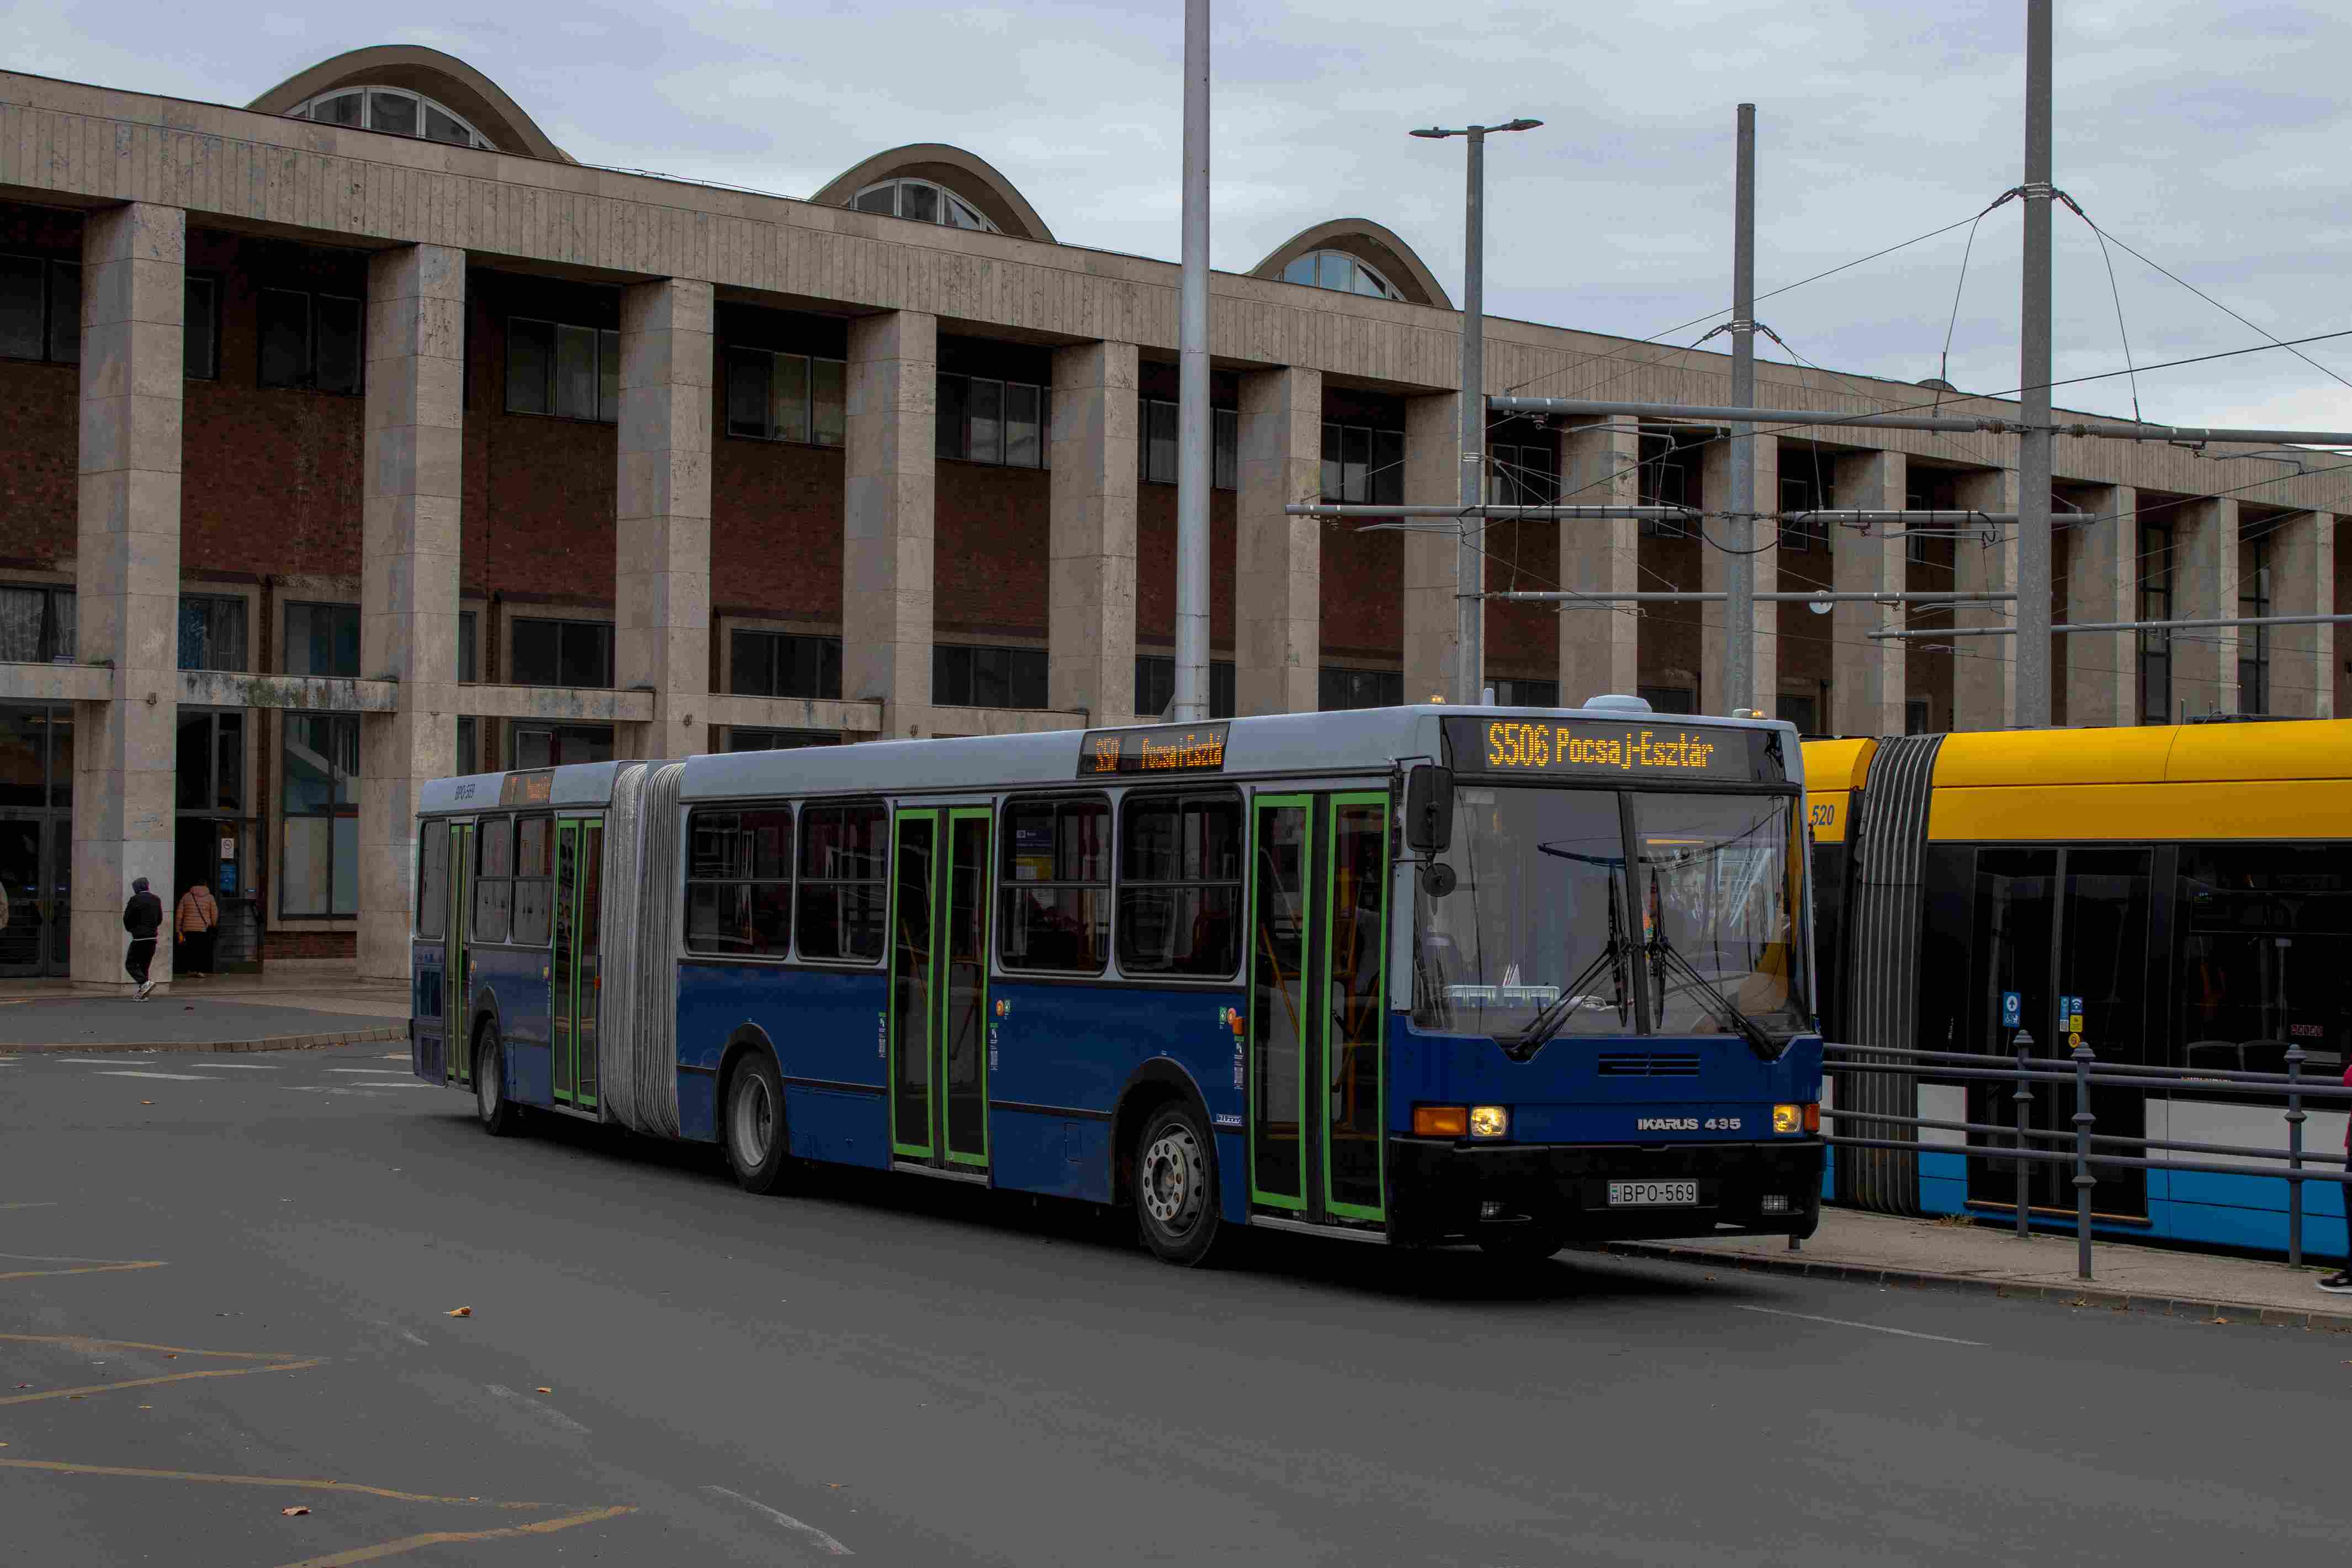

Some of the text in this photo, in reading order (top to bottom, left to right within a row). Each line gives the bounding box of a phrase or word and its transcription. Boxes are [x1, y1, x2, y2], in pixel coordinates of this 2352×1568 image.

[1489, 722, 1714, 770] S506 Pocsaj-Esztár
[1811, 804, 1835, 826] 520
[1637, 1118, 1741, 1130] IKARUS 435
[1623, 1184, 1694, 1202] BPO-569
